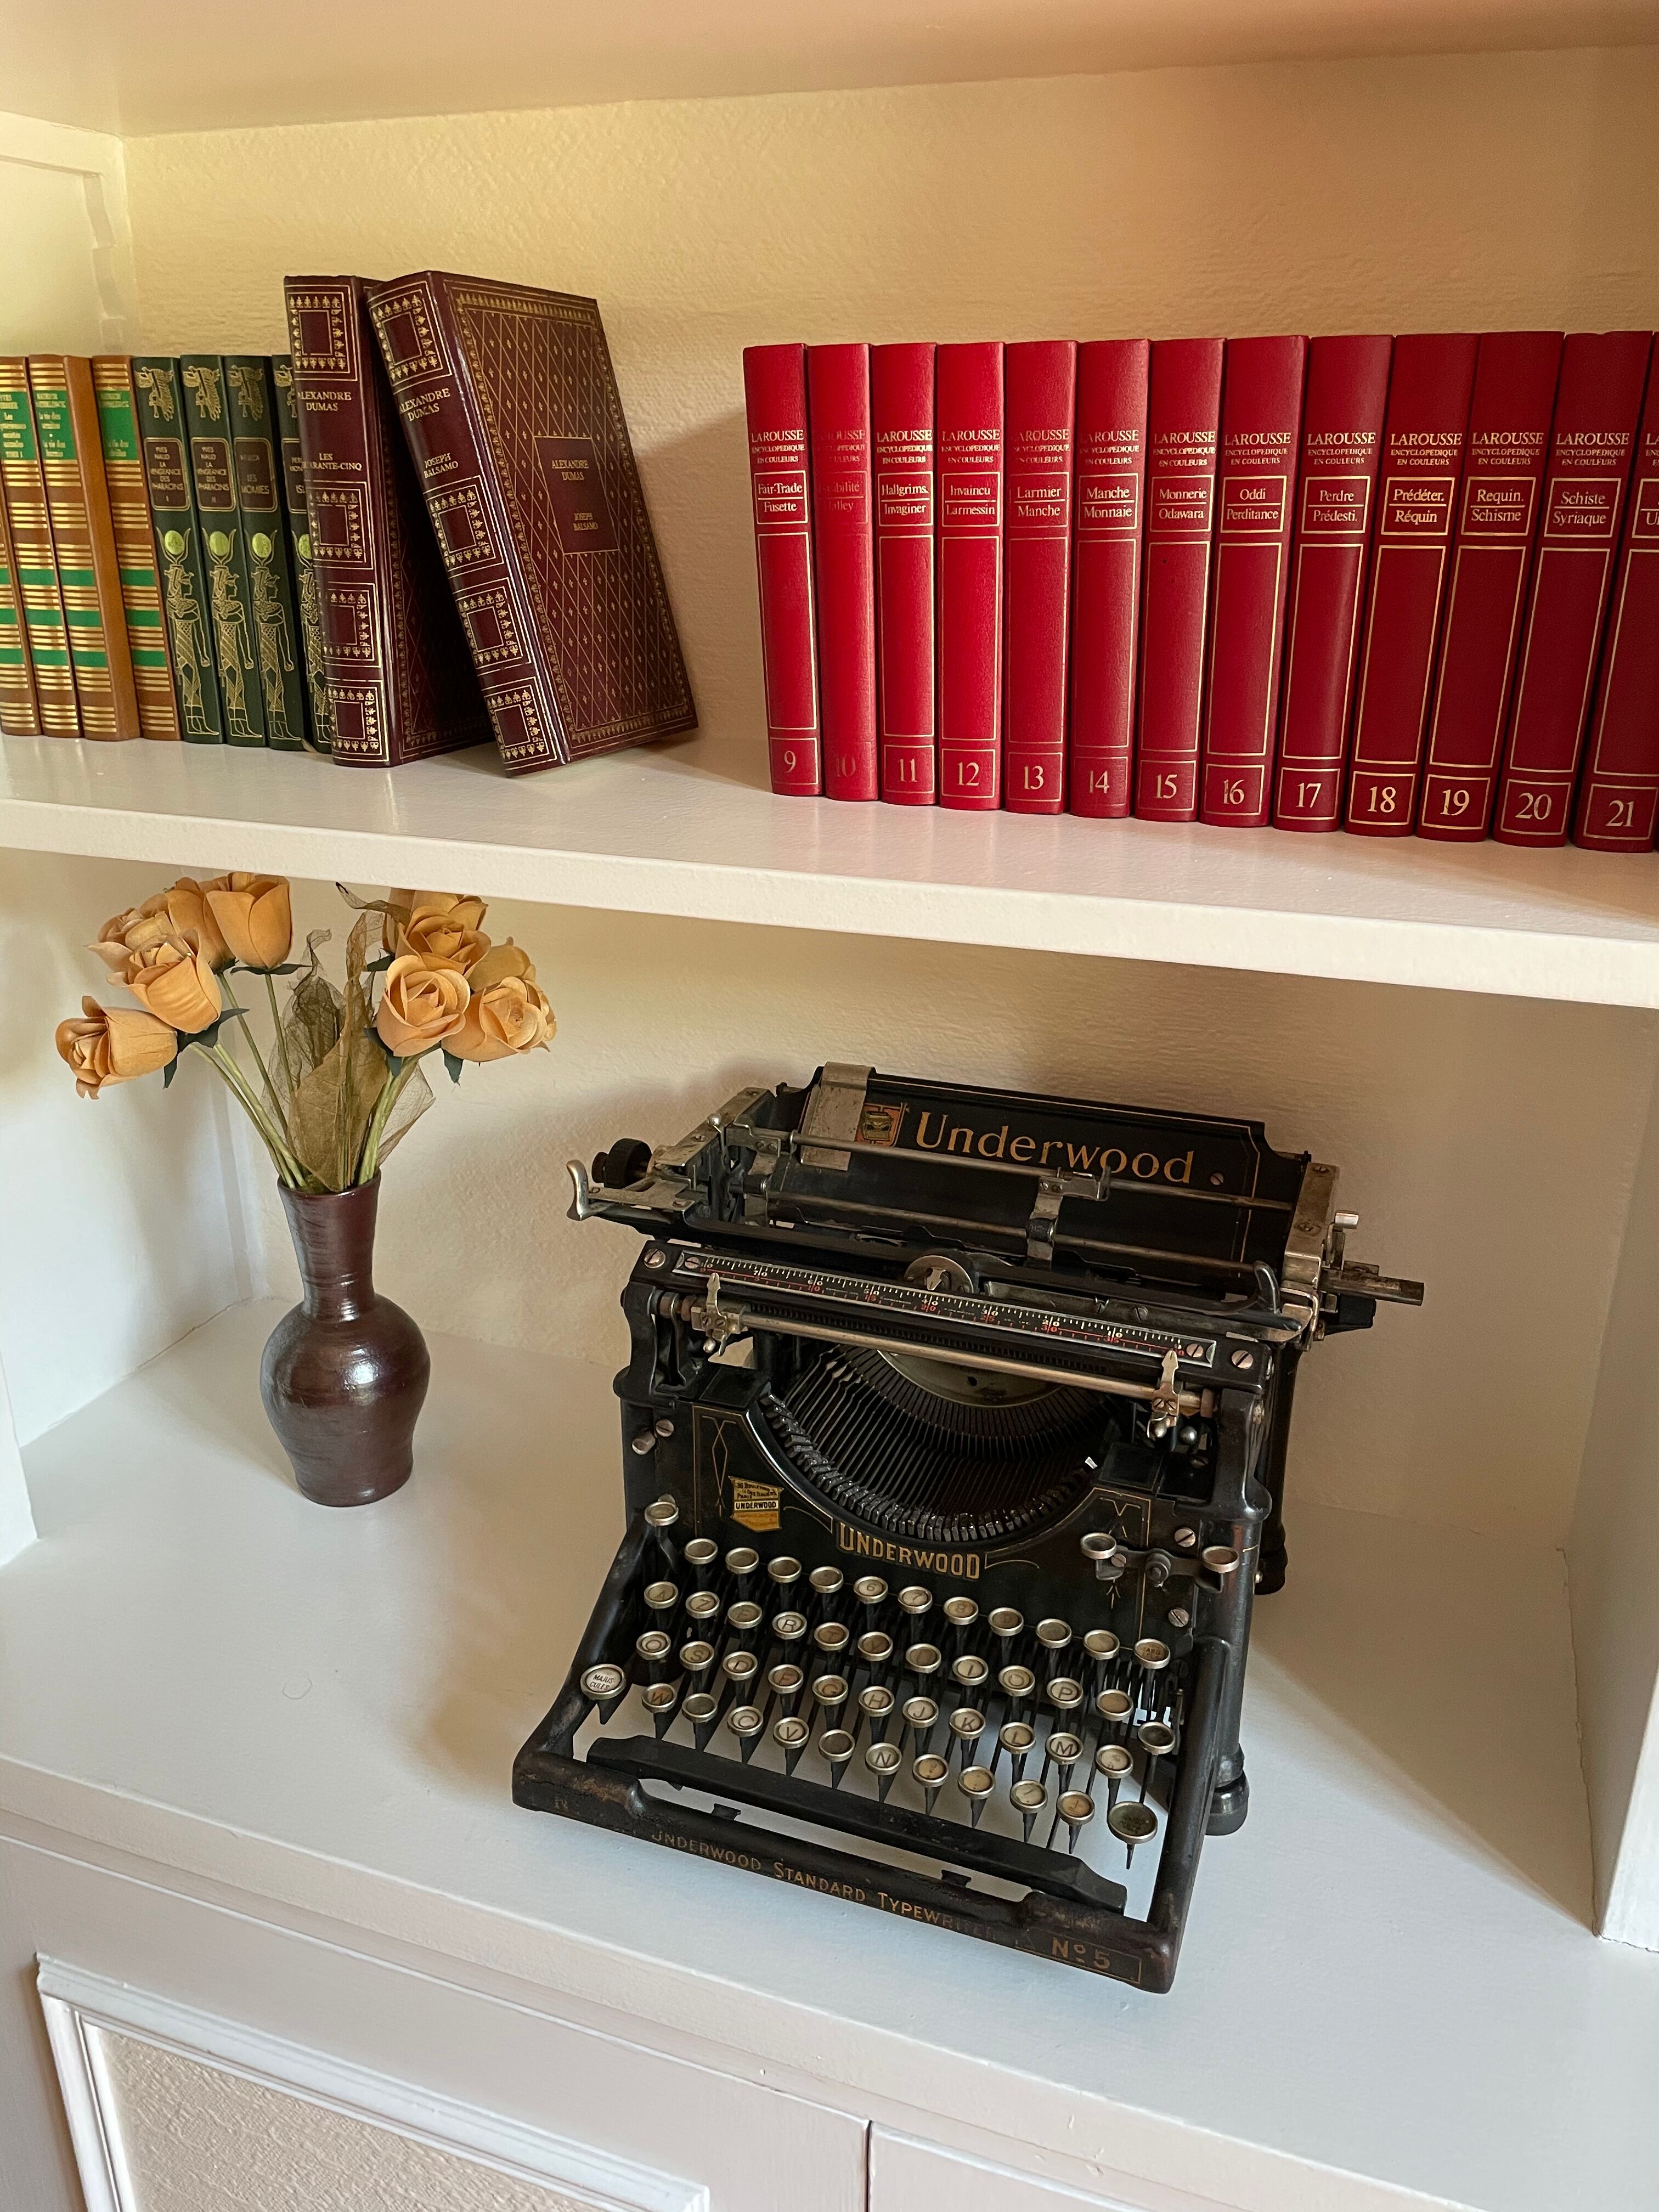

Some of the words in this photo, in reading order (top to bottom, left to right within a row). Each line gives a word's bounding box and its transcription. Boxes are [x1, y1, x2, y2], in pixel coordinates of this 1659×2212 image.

[297, 392, 352, 400] ALEXANDRE
[399, 387, 451, 414] ALEXANDRE
[306, 402, 338, 411] DUMAS
[408, 403, 440, 421] DUMAS
[752, 430, 804, 443] LAROUSSE
[877, 429, 933, 443] LAROUSSE
[942, 429, 1000, 442] LAROUSSE
[1154, 431, 1216, 444] LAROUSSE
[1224, 432, 1291, 446] LAROUSSE
[1307, 432, 1376, 445] LAROUSSE
[1390, 432, 1463, 446] LAROUSSE
[1471, 432, 1544, 446] LAROUSSE
[1556, 432, 1630, 446] LAROUSSE
[752, 444, 805, 453] ENCYCLOPEDIQUE
[877, 444, 933, 454] ENCYCLOPEDIQUE
[1153, 447, 1216, 456] ENCYCLOPEDIQUE
[1224, 447, 1288, 456] ENCYCLOPEDIQUE
[1307, 447, 1373, 456] ENCYCLOPEDIQUE
[1391, 448, 1458, 457] ENCYCLOPEDIQUE
[319, 453, 332, 461] LES
[424, 453, 451, 469] JOSEPH
[1169, 458, 1207, 466] COULEURS
[1409, 458, 1449, 466] COULEURS
[1575, 458, 1617, 466] COULEURS
[423, 461, 459, 478] BALSAMO
[552, 460, 589, 469] ALEXANDRE
[562, 471, 584, 481] DUMAS
[758, 483, 803, 494] Fair-Trade
[882, 484, 929, 496] Hallgrims.
[950, 485, 991, 496] Invaincu
[1017, 486, 1062, 499] Larmier
[1086, 486, 1130, 499] Manche
[1159, 488, 1207, 500] Monnerie
[1239, 488, 1266, 501] Oddi
[1393, 488, 1444, 502] Prédéter.
[1319, 490, 1355, 502] Perdre
[1477, 488, 1524, 503] Requin.
[1561, 491, 1606, 505] Schiste
[764, 501, 797, 512] Fusette
[884, 503, 926, 515] Invaginer
[946, 504, 995, 515] Larmessin
[1018, 504, 1061, 517] Manche
[1084, 505, 1133, 518] Monnaie
[574, 512, 592, 521] JOSEPH
[1158, 508, 1204, 520] Odawara
[1227, 507, 1279, 520] Perditance
[1313, 509, 1358, 522] Prédesti.
[1395, 510, 1437, 525] Réquin
[1471, 509, 1521, 522] Schisme
[1553, 511, 1607, 527] Syriaque
[573, 522, 599, 531] BALSAMO
[783, 749, 798, 774] 9
[835, 754, 857, 778] 10
[898, 758, 918, 783] 11
[956, 761, 980, 787] 12
[1023, 764, 1045, 791] 13
[1087, 769, 1110, 795] 14
[1155, 773, 1178, 800] 15
[1222, 778, 1245, 806] 16
[1294, 781, 1323, 809] 17
[1366, 785, 1397, 814] 18
[1438, 788, 1471, 817] 19
[1514, 792, 1553, 821] 20
[1604, 799, 1635, 828] 21
[916, 1111, 1195, 1185] Underwood
[864, 1294, 877, 1302] 15
[921, 1304, 937, 1312] 20
[1041, 1325, 1058, 1333] 30
[921, 1298, 938, 1306] 40
[1042, 1319, 1060, 1328] 20
[839, 1522, 980, 1579] UNDERWOOD
[695, 1599, 711, 1610] Z
[782, 1619, 797, 1633] R
[1008, 1675, 1024, 1688] O
[1058, 1686, 1074, 1699] P
[589, 1681, 610, 1690] CULES
[691, 1650, 703, 1661] S
[822, 1684, 839, 1696] G
[868, 1694, 884, 1708] H
[912, 1706, 926, 1718] J
[961, 1717, 976, 1730] K
[1013, 1730, 1026, 1744] L
[1055, 1741, 1074, 1755] M
[738, 1716, 754, 1728] C
[787, 1727, 798, 1740] V
[875, 1751, 891, 1767] N
[651, 1830, 762, 1871] UNDERWOOD
[773, 1861, 866, 1903] STANDARD
